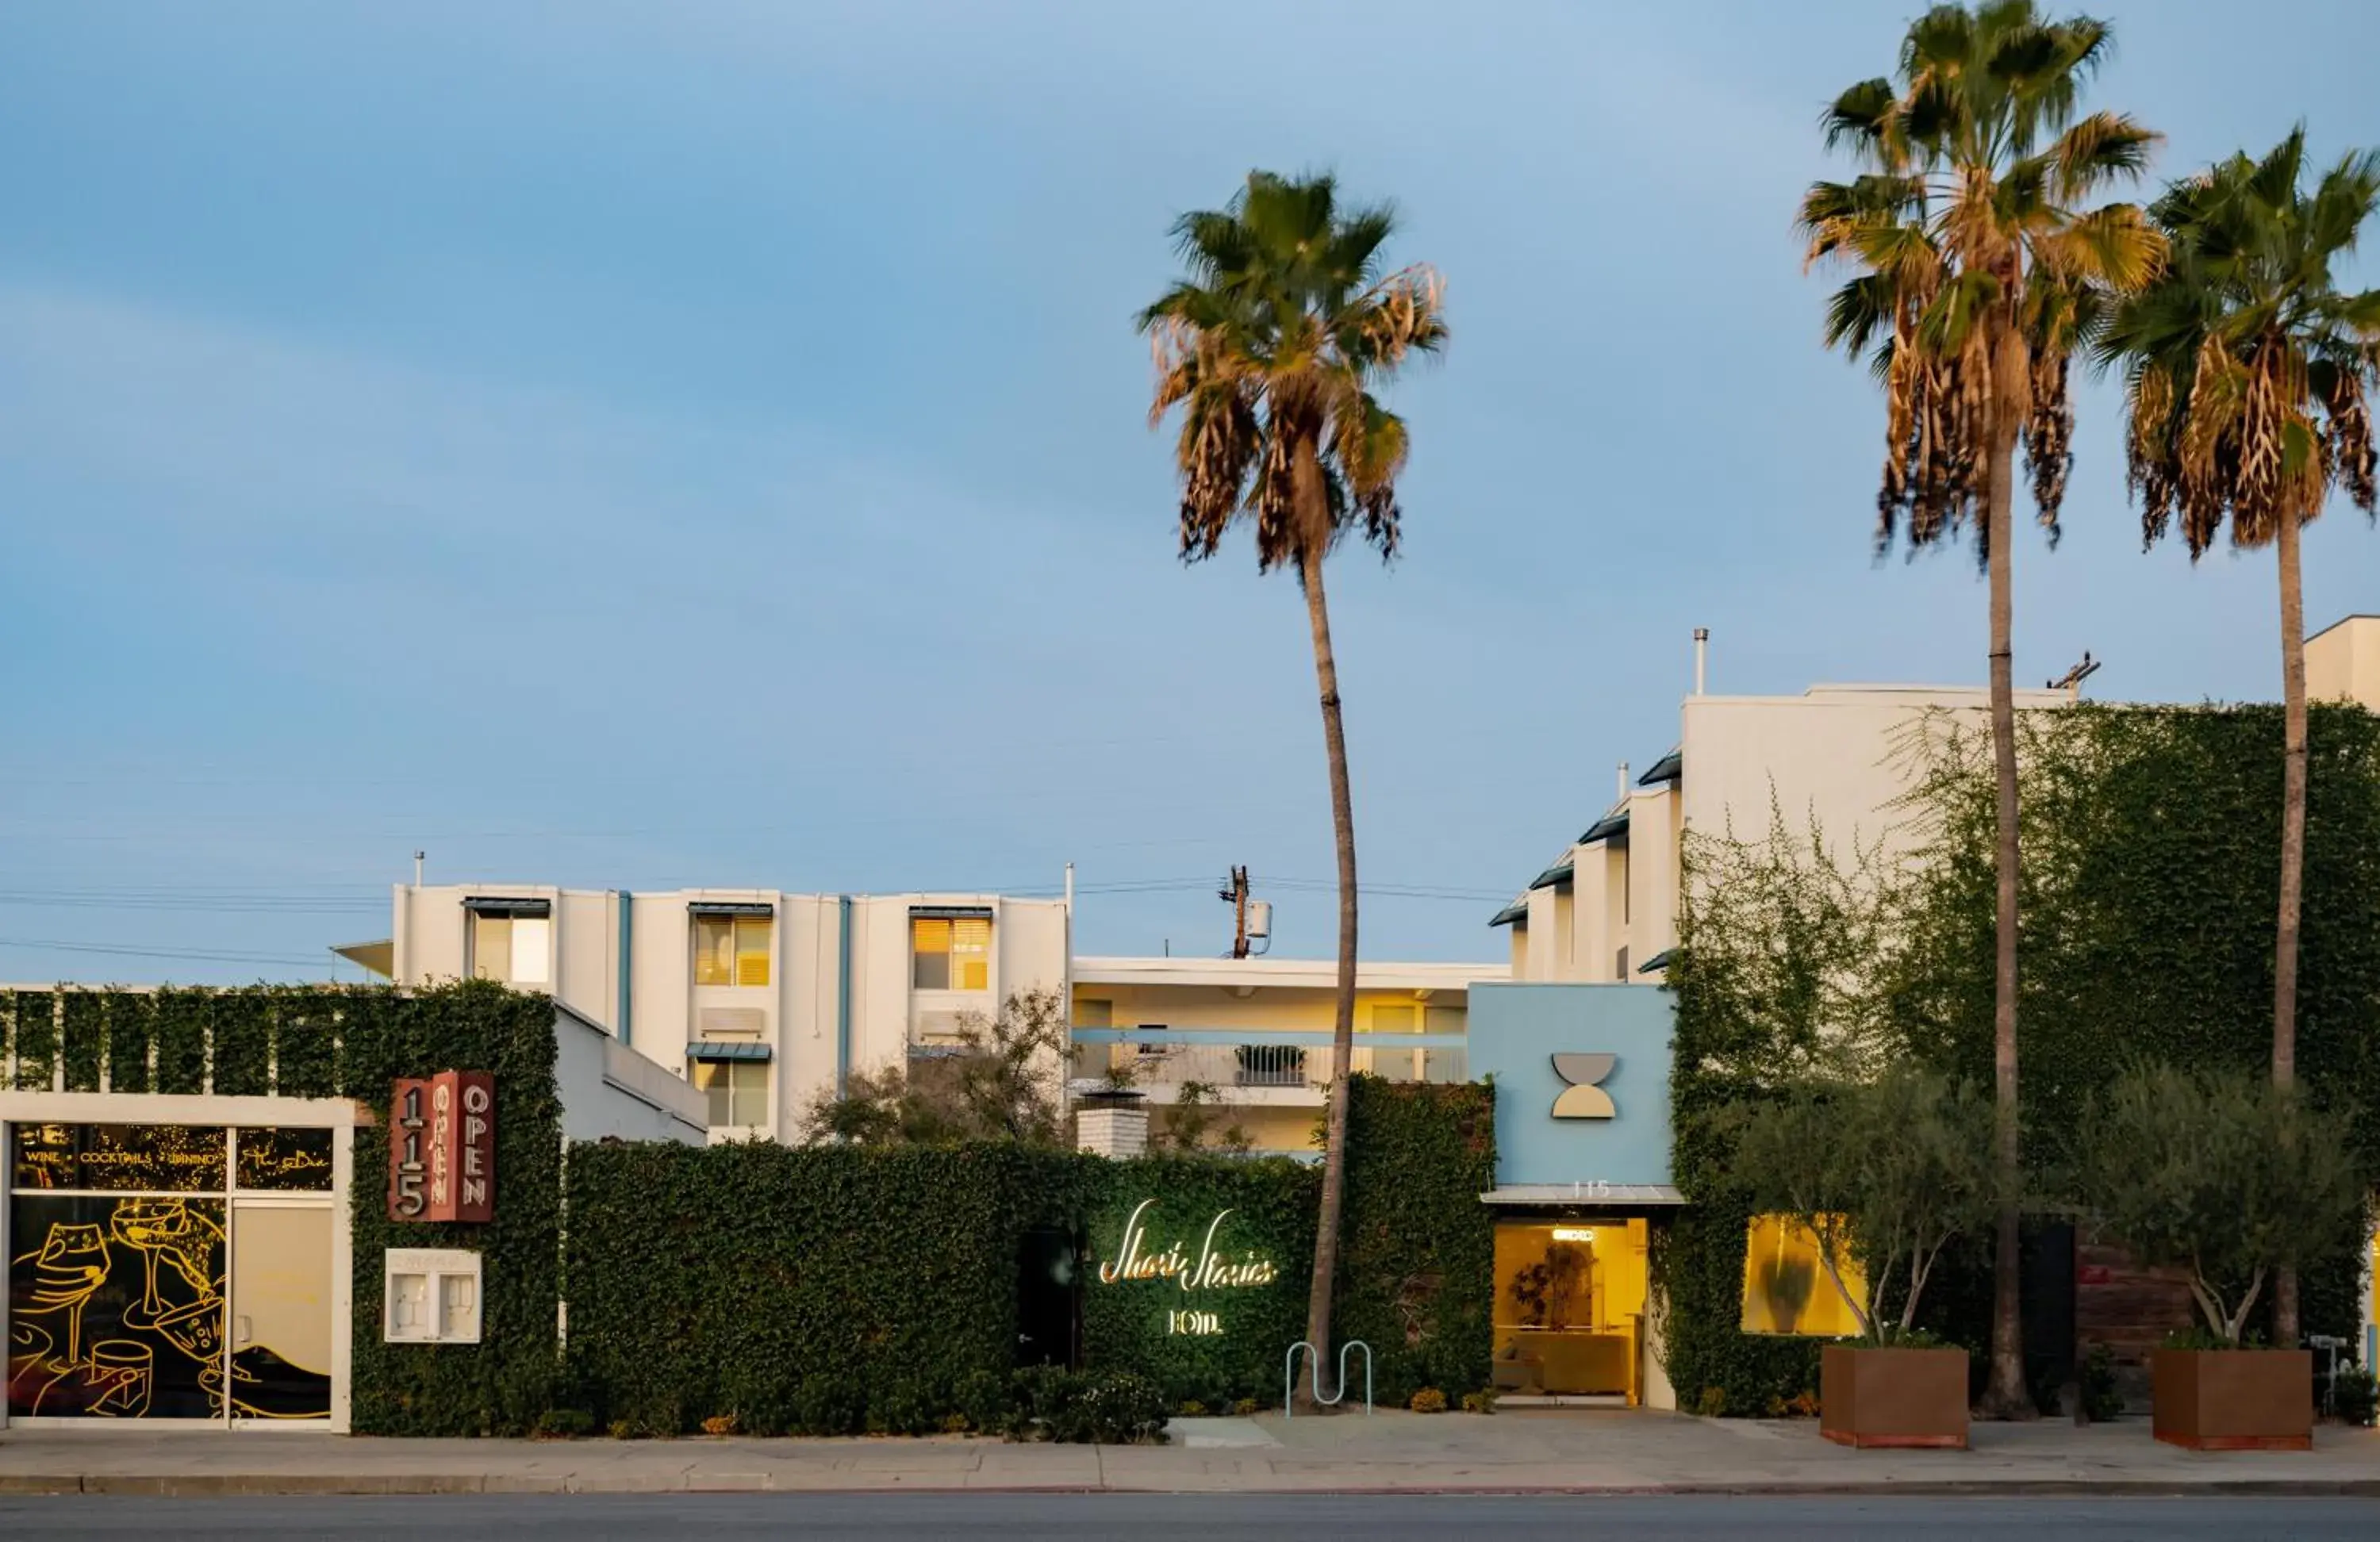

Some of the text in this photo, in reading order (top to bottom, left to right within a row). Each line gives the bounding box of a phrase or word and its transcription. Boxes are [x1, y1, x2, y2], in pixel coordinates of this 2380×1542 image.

[25, 1151, 61, 1163] WINE
[463, 1084, 489, 1206] OPEN
[1574, 1179, 1610, 1199] 115
[1100, 1198, 1188, 1284] Short
